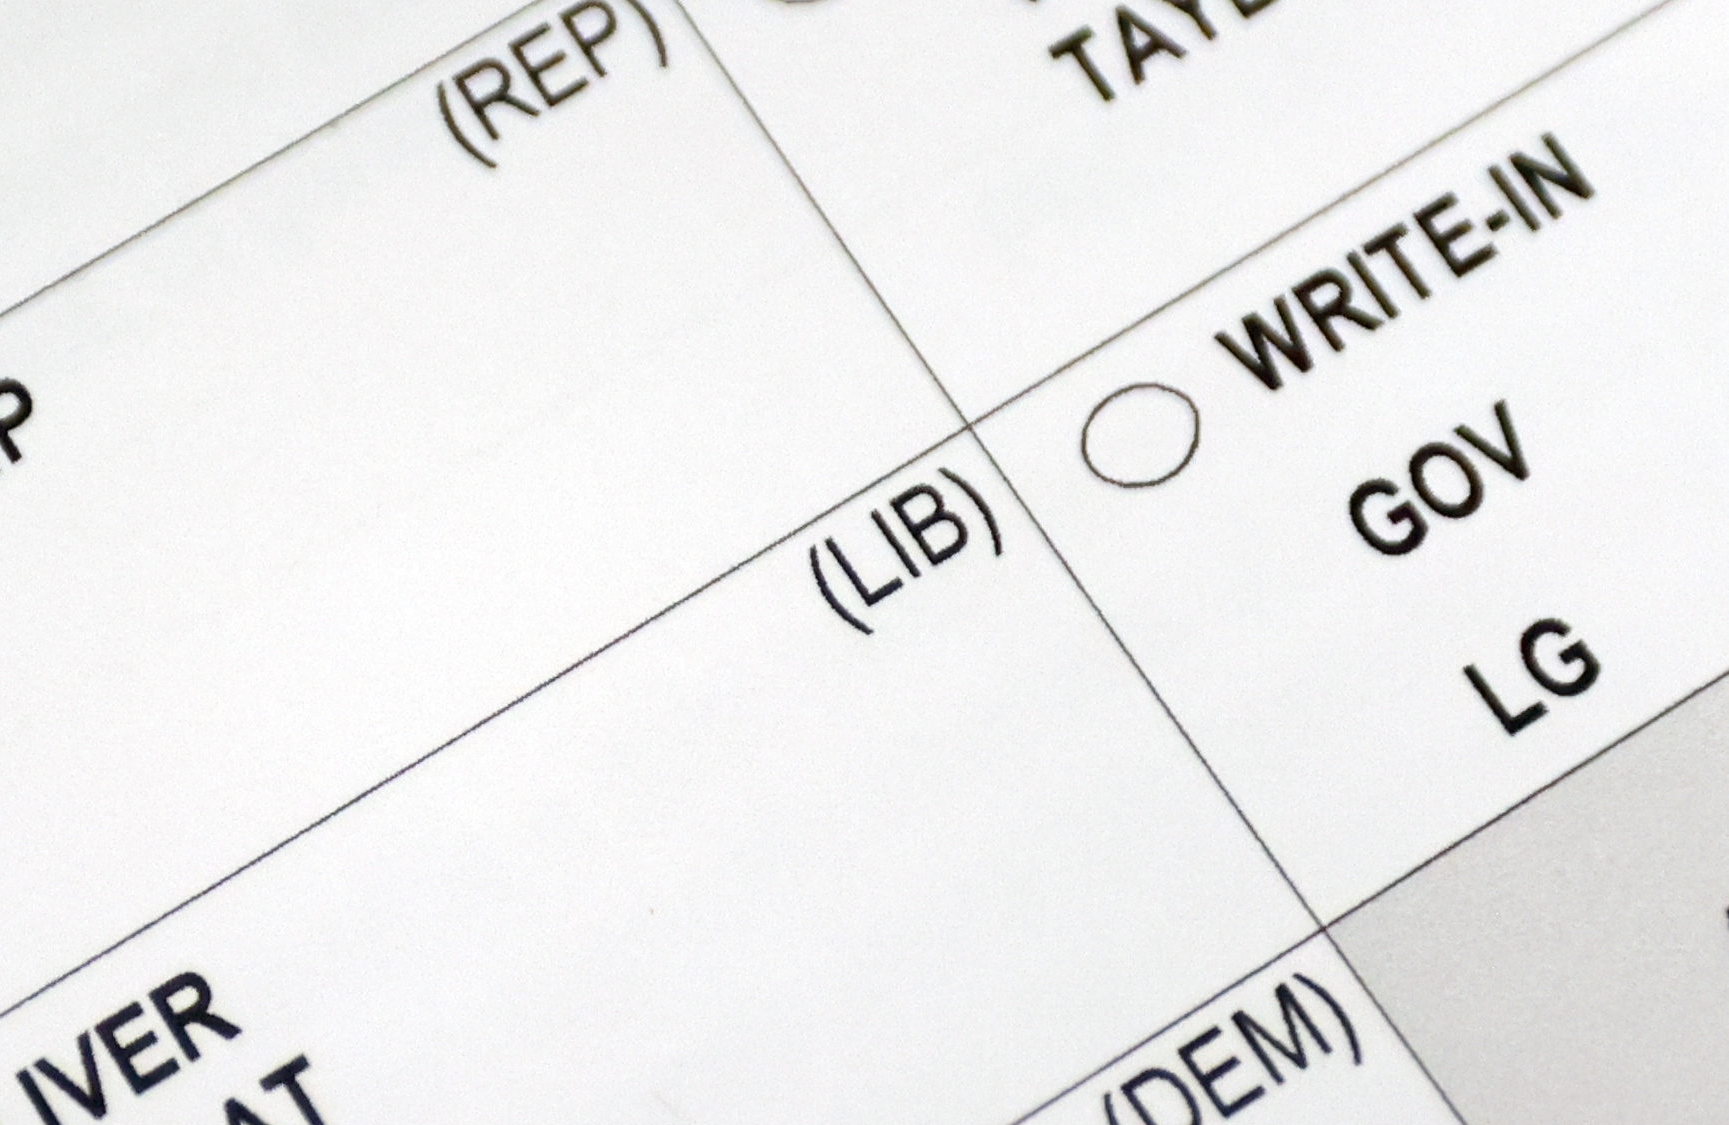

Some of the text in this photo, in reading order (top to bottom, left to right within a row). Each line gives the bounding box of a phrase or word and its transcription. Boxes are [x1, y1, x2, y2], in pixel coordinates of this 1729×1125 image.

[435, 0, 669, 170] (REP)
[1047, 0, 1279, 104] TAY
[1212, 132, 1596, 393] WRITE-IN
[808, 466, 1004, 637] (LIB)
[1346, 398, 1531, 558] GOV
[1461, 616, 1602, 739] LG
